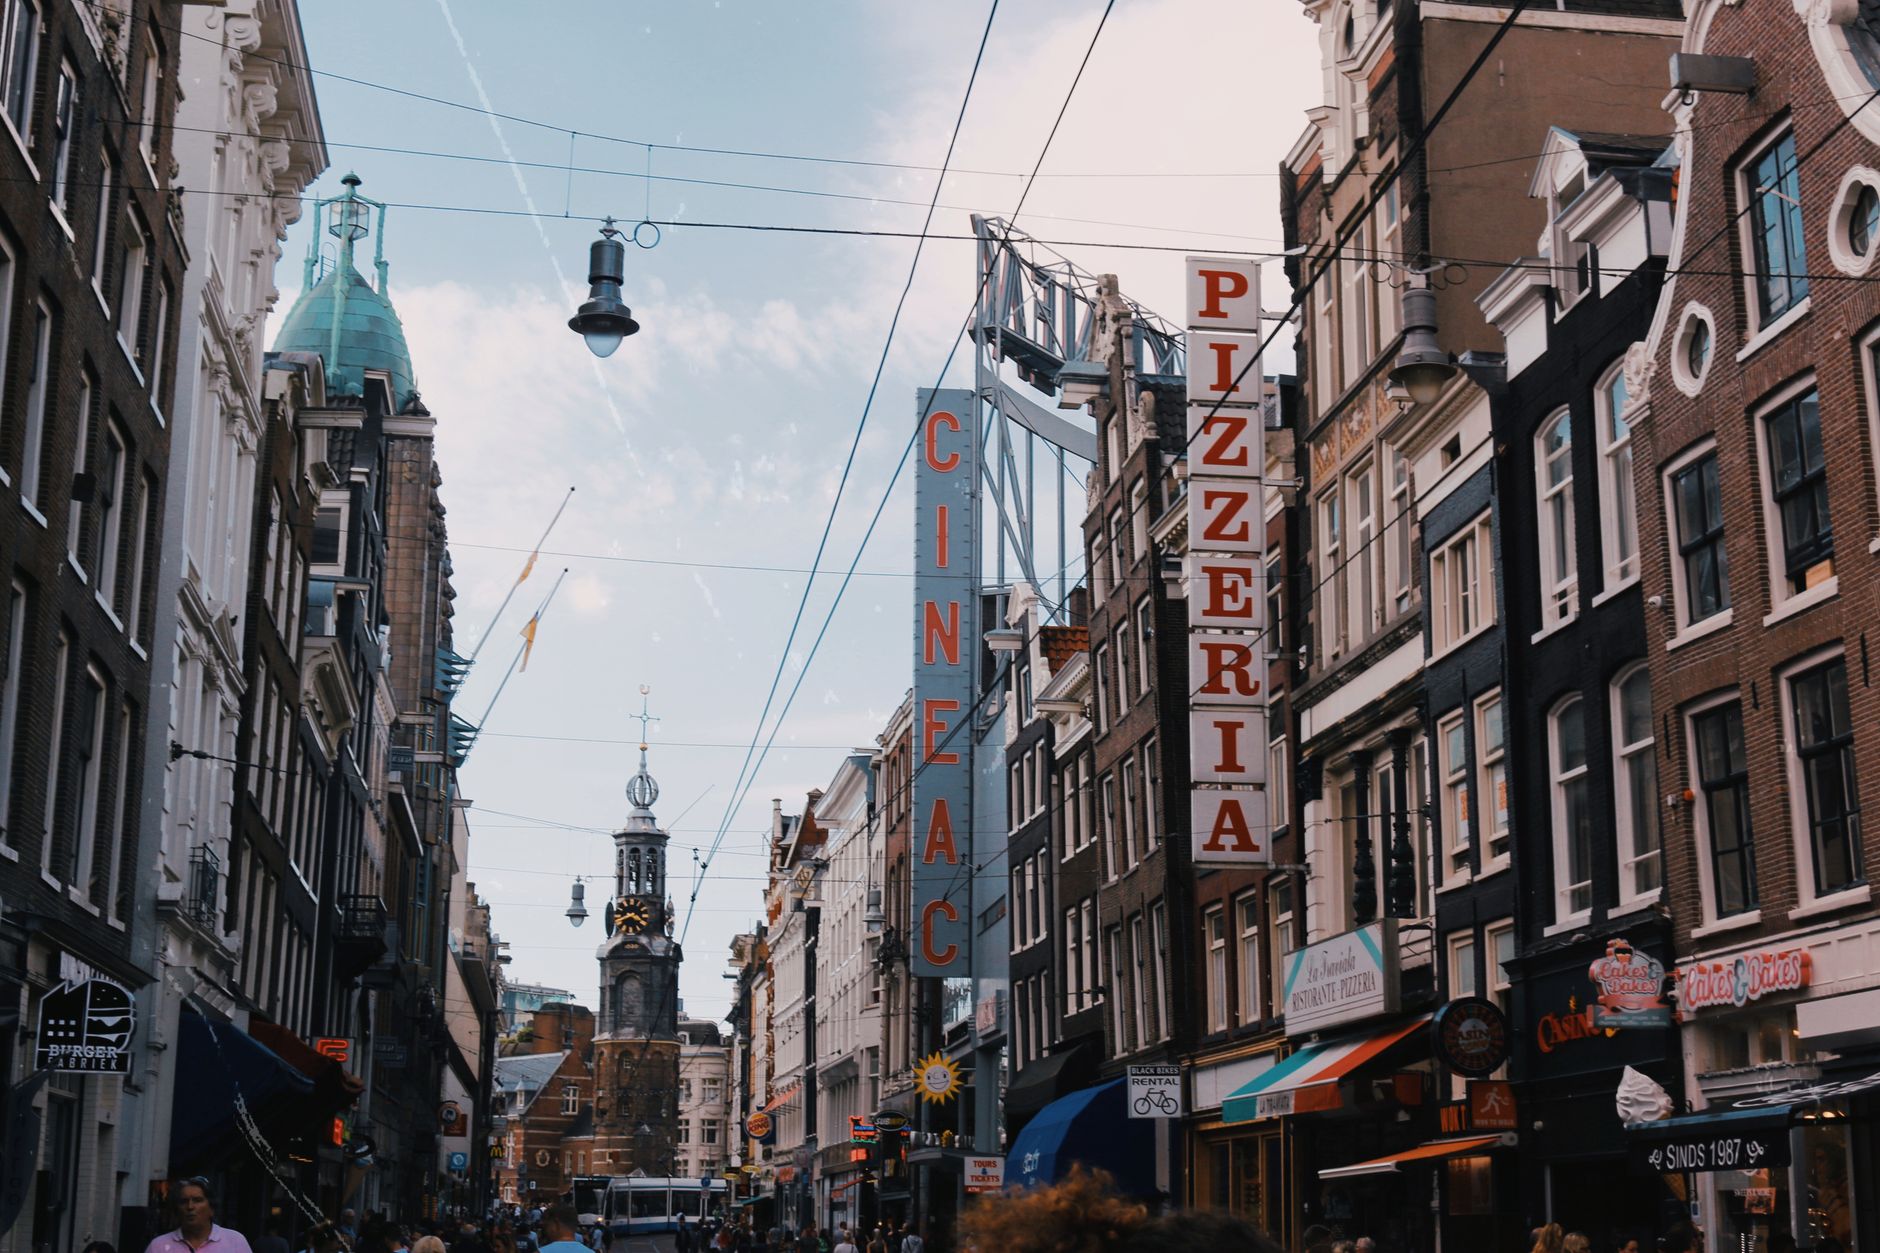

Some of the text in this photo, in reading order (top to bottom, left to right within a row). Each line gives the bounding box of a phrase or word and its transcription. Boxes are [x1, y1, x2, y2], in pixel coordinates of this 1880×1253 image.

[1197, 269, 1261, 853] PIZZERIA
[921, 410, 962, 967] CINEAC
[1600, 962, 1648, 979] Cakes
[1685, 965, 1733, 1007] Cakes
[1747, 954, 1800, 996] Bakes
[1292, 982, 1337, 1012] RISTORANTE
[1341, 970, 1376, 1000] PIZZERIA
[1608, 978, 1658, 993] Bakes
[1537, 1011, 1601, 1053] CASIN
[48, 1044, 118, 1058] BURGER
[1131, 1066, 1179, 1075] BLACK BIKES
[1132, 1077, 1180, 1086] RENTAL
[972, 1160, 997, 1168] TOURS
[1666, 1138, 1742, 1170] SINDS 1987
